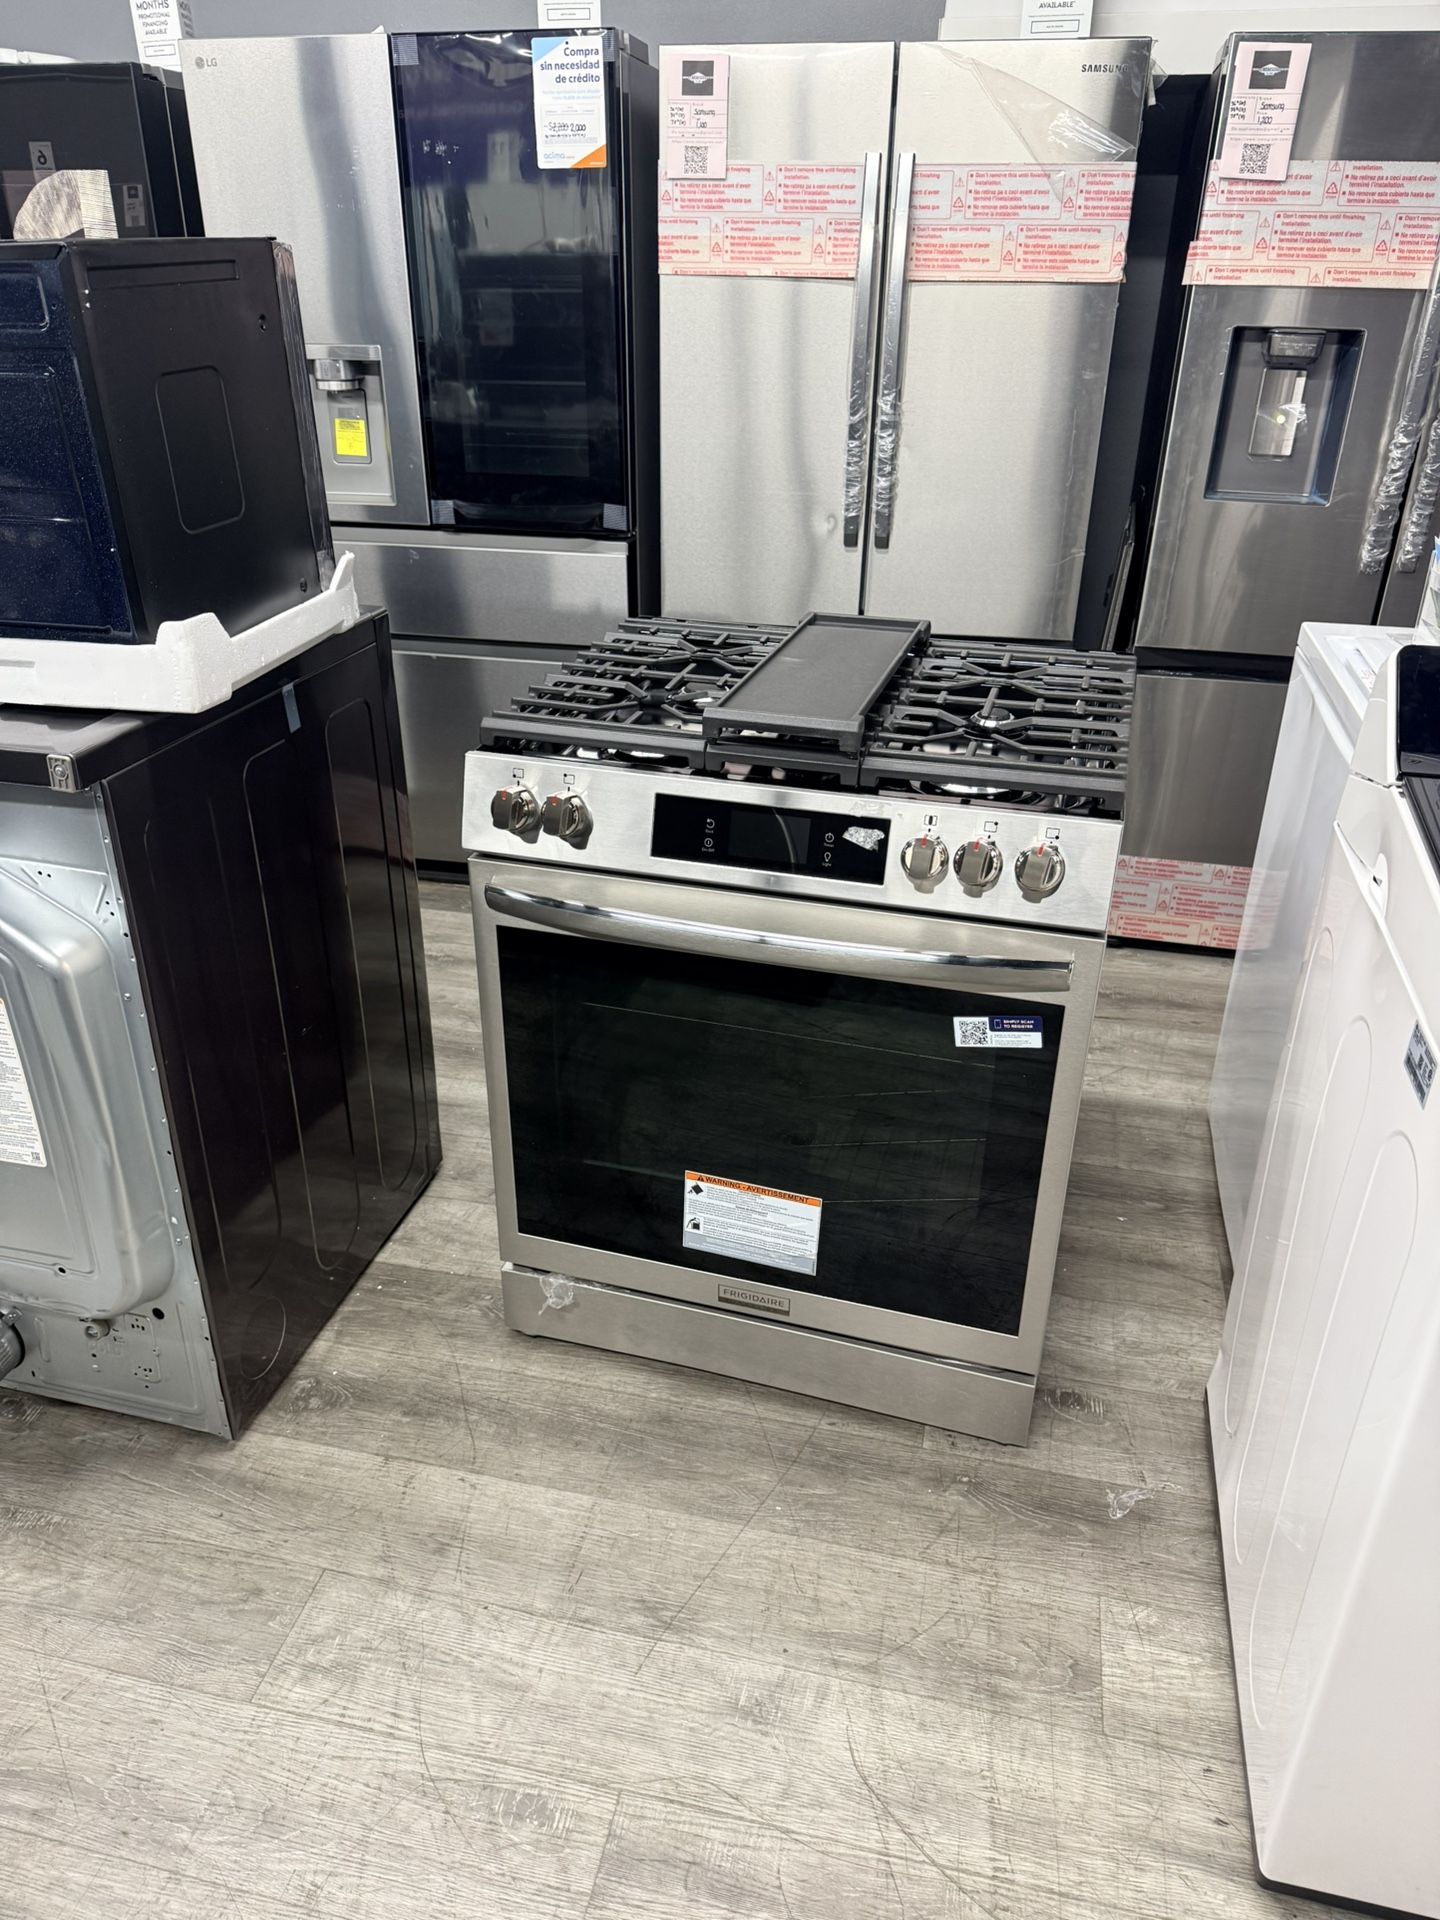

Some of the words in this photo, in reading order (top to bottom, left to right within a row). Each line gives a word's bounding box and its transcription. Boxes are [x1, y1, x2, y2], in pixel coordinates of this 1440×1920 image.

[136, 0, 169, 10] MONTHS
[564, 47, 599, 58] Compra
[540, 61, 552, 70] sin
[554, 60, 600, 70] necesidad
[555, 74, 566, 83] de
[568, 73, 600, 83] crédito
[1260, 102, 1285, 112] Samsung
[694, 108, 715, 117] Samsung
[706, 1176, 741, 1189] WARNING
[747, 1185, 809, 1204] AVERTISSEMENT
[724, 1289, 784, 1307] FRIGIDAIRE
